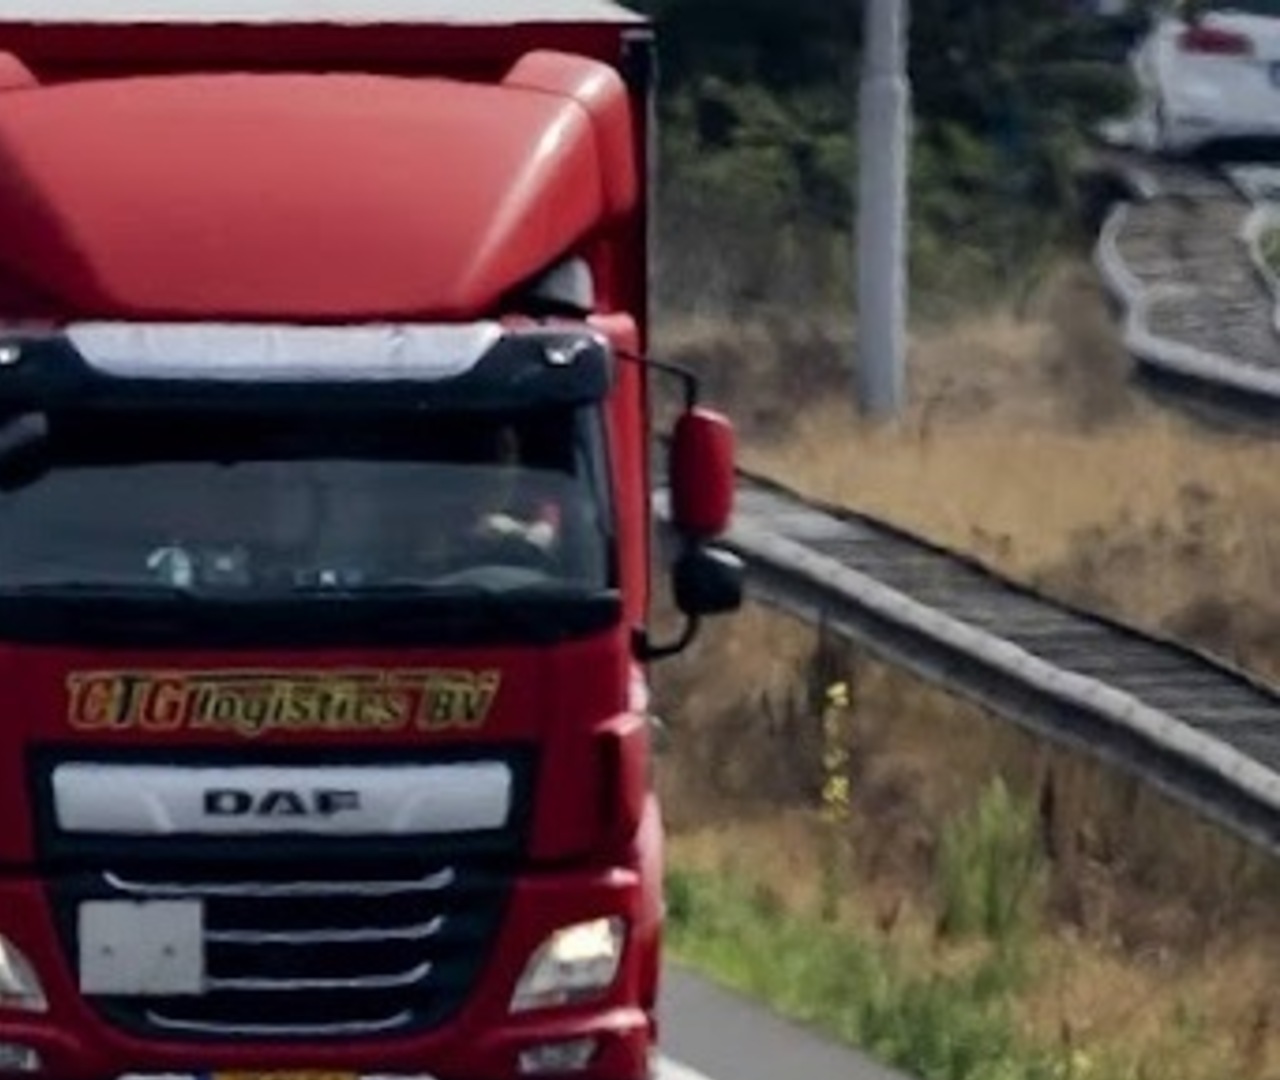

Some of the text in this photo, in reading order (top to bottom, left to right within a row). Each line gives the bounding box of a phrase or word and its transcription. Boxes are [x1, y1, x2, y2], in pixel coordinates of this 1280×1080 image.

[190, 674, 406, 735] logistics
[420, 673, 500, 728] BV
[203, 789, 361, 816] DAF
